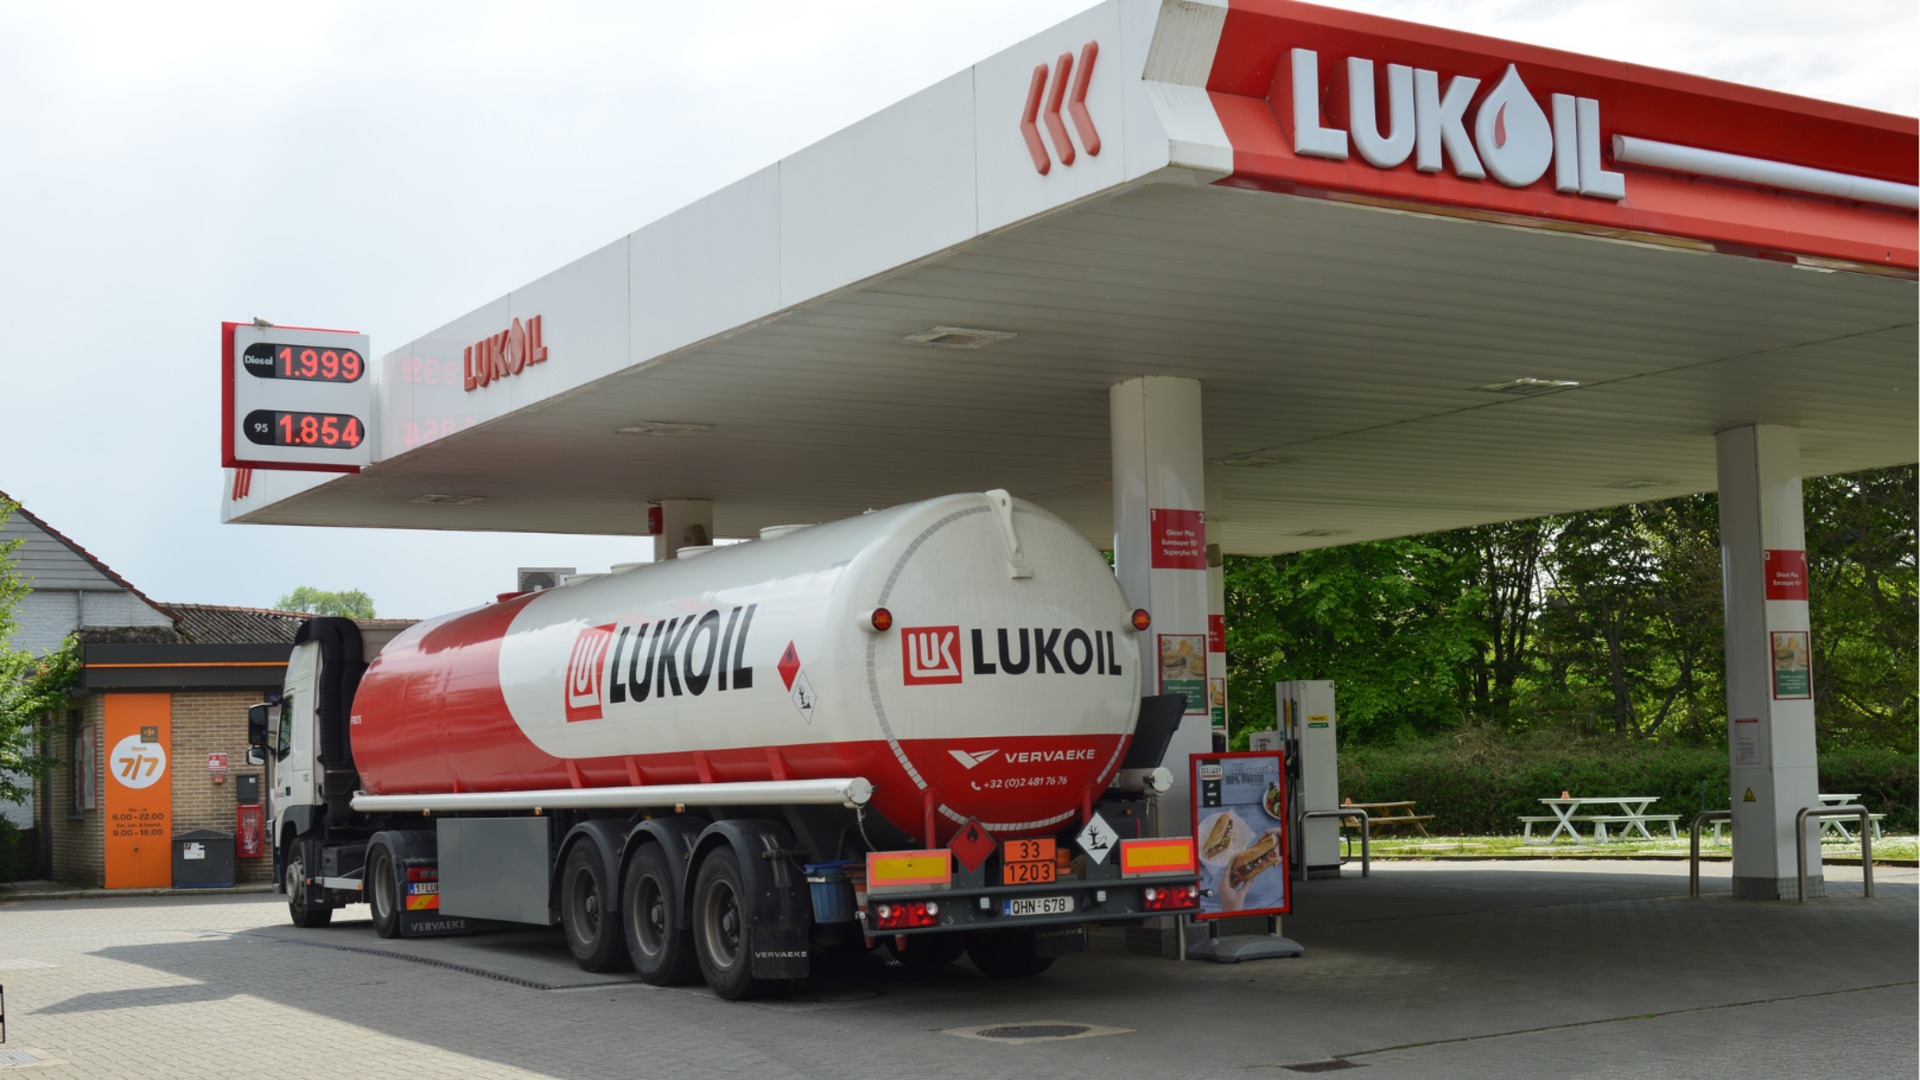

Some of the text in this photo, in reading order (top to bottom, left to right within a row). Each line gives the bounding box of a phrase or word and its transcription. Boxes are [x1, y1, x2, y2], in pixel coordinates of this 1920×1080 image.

[1291, 47, 1625, 201] LUKOIL
[463, 314, 547, 392] LUKOIL
[244, 346, 359, 380] Diesel 1.999
[254, 414, 359, 447] 95 1.854
[1151, 510, 1157, 522] 1
[1199, 512, 1205, 524] 2
[1764, 551, 1771, 561] 3
[609, 603, 758, 704] LUKOIL
[971, 627, 1122, 676] LUKOIL
[1004, 749, 1096, 764] VERVAEKE
[118, 754, 159, 780] 7/7
[983, 775, 1068, 789] +32 (0)2 481 76 76
[1020, 841, 1041, 859] 33
[1008, 864, 1051, 883] 1203
[411, 920, 466, 932] VERVAEKE
[754, 950, 808, 959] VERVAEKE
